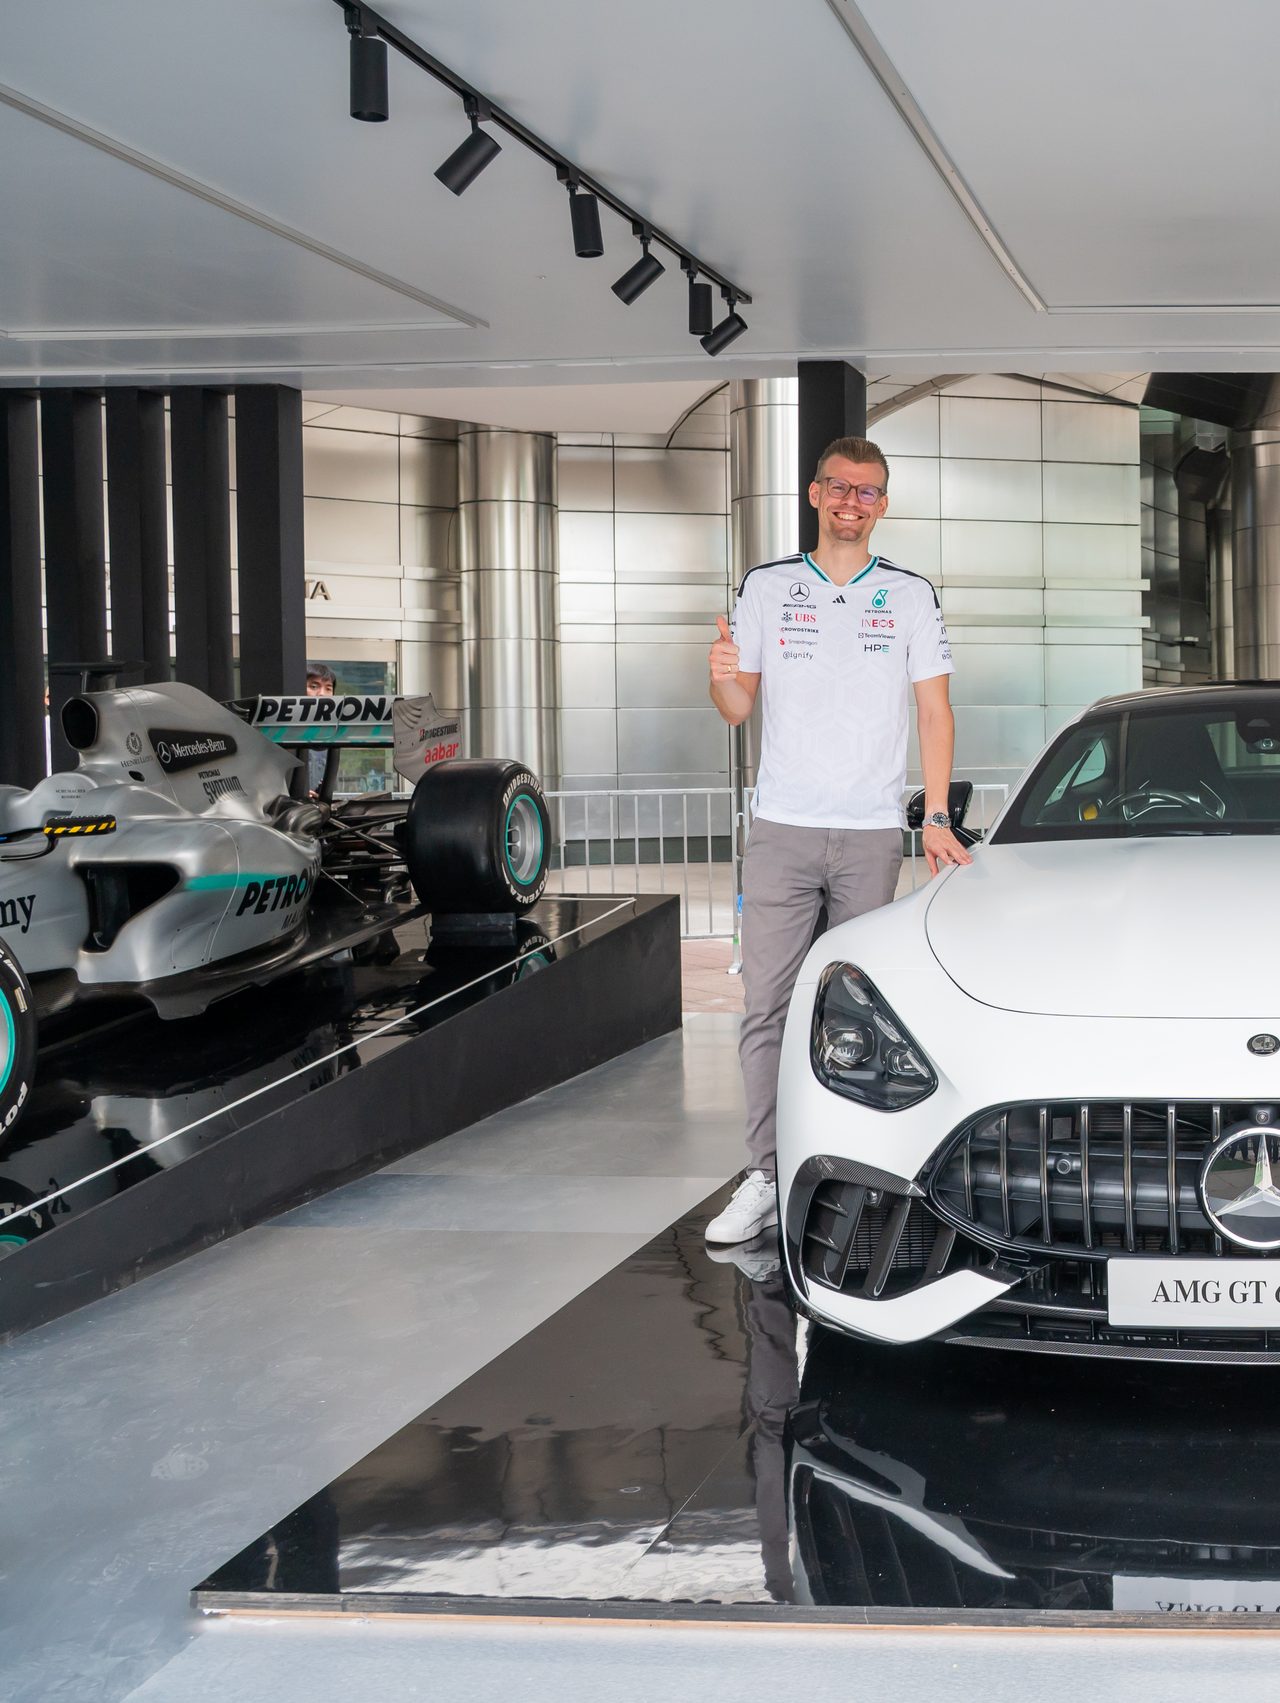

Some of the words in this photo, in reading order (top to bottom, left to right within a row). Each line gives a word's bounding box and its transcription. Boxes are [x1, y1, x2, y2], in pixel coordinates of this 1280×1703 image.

[795, 613, 816, 623] UBS
[861, 619, 895, 628] INEOS
[864, 644, 889, 653] HPE
[171, 739, 227, 758] Mercedes-Benz
[424, 742, 459, 764] aabar
[502, 773, 542, 810] BRIDGESTONE
[236, 857, 319, 916] PETRO
[1152, 1280, 1222, 1304] AMG
[1228, 1280, 1267, 1304] GT
